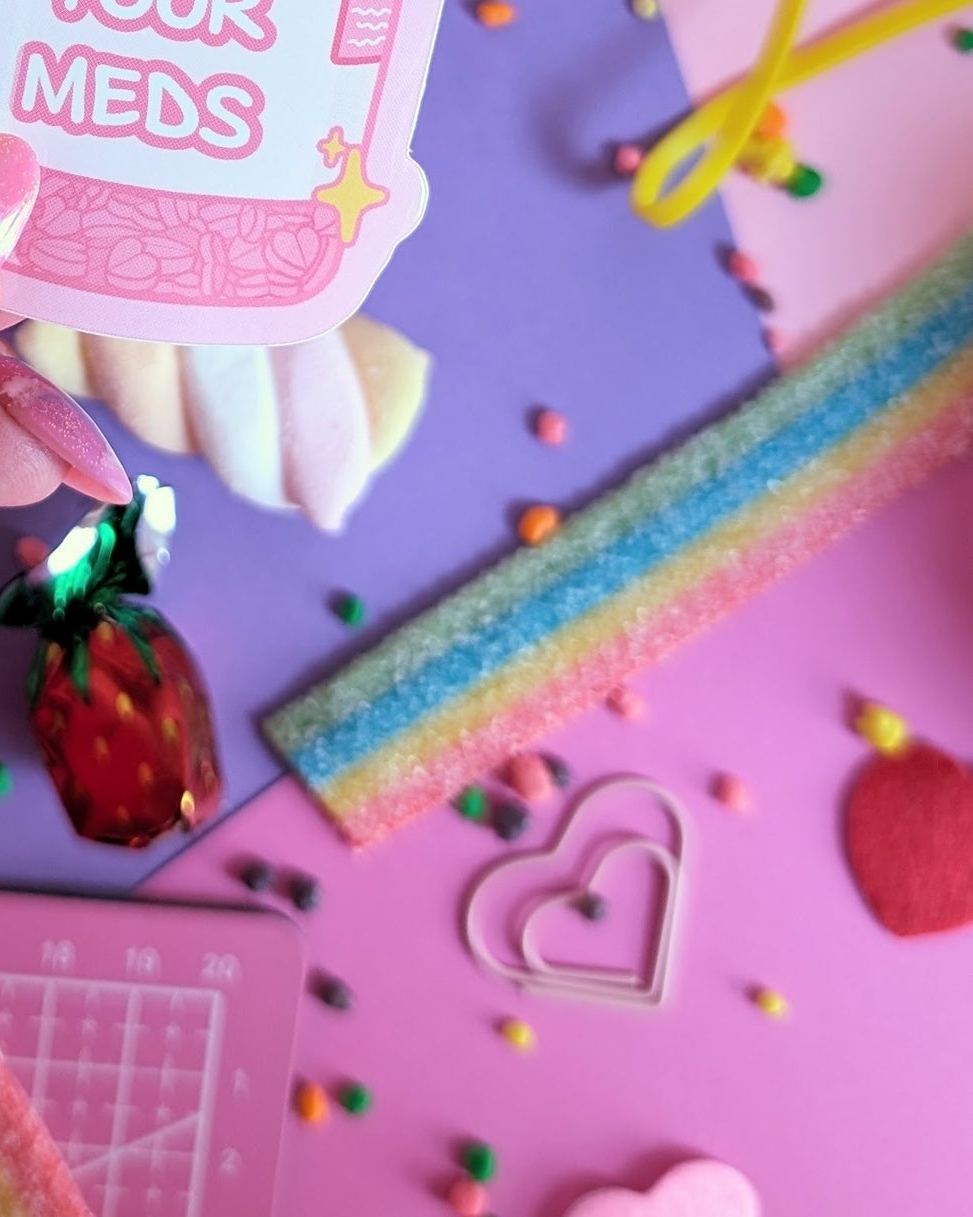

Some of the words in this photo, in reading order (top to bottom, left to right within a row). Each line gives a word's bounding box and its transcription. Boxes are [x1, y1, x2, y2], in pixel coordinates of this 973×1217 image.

[16, 48, 261, 153] MEDS
[41, 938, 76, 970] 18
[125, 945, 162, 977] 19
[201, 952, 241, 982] 20
